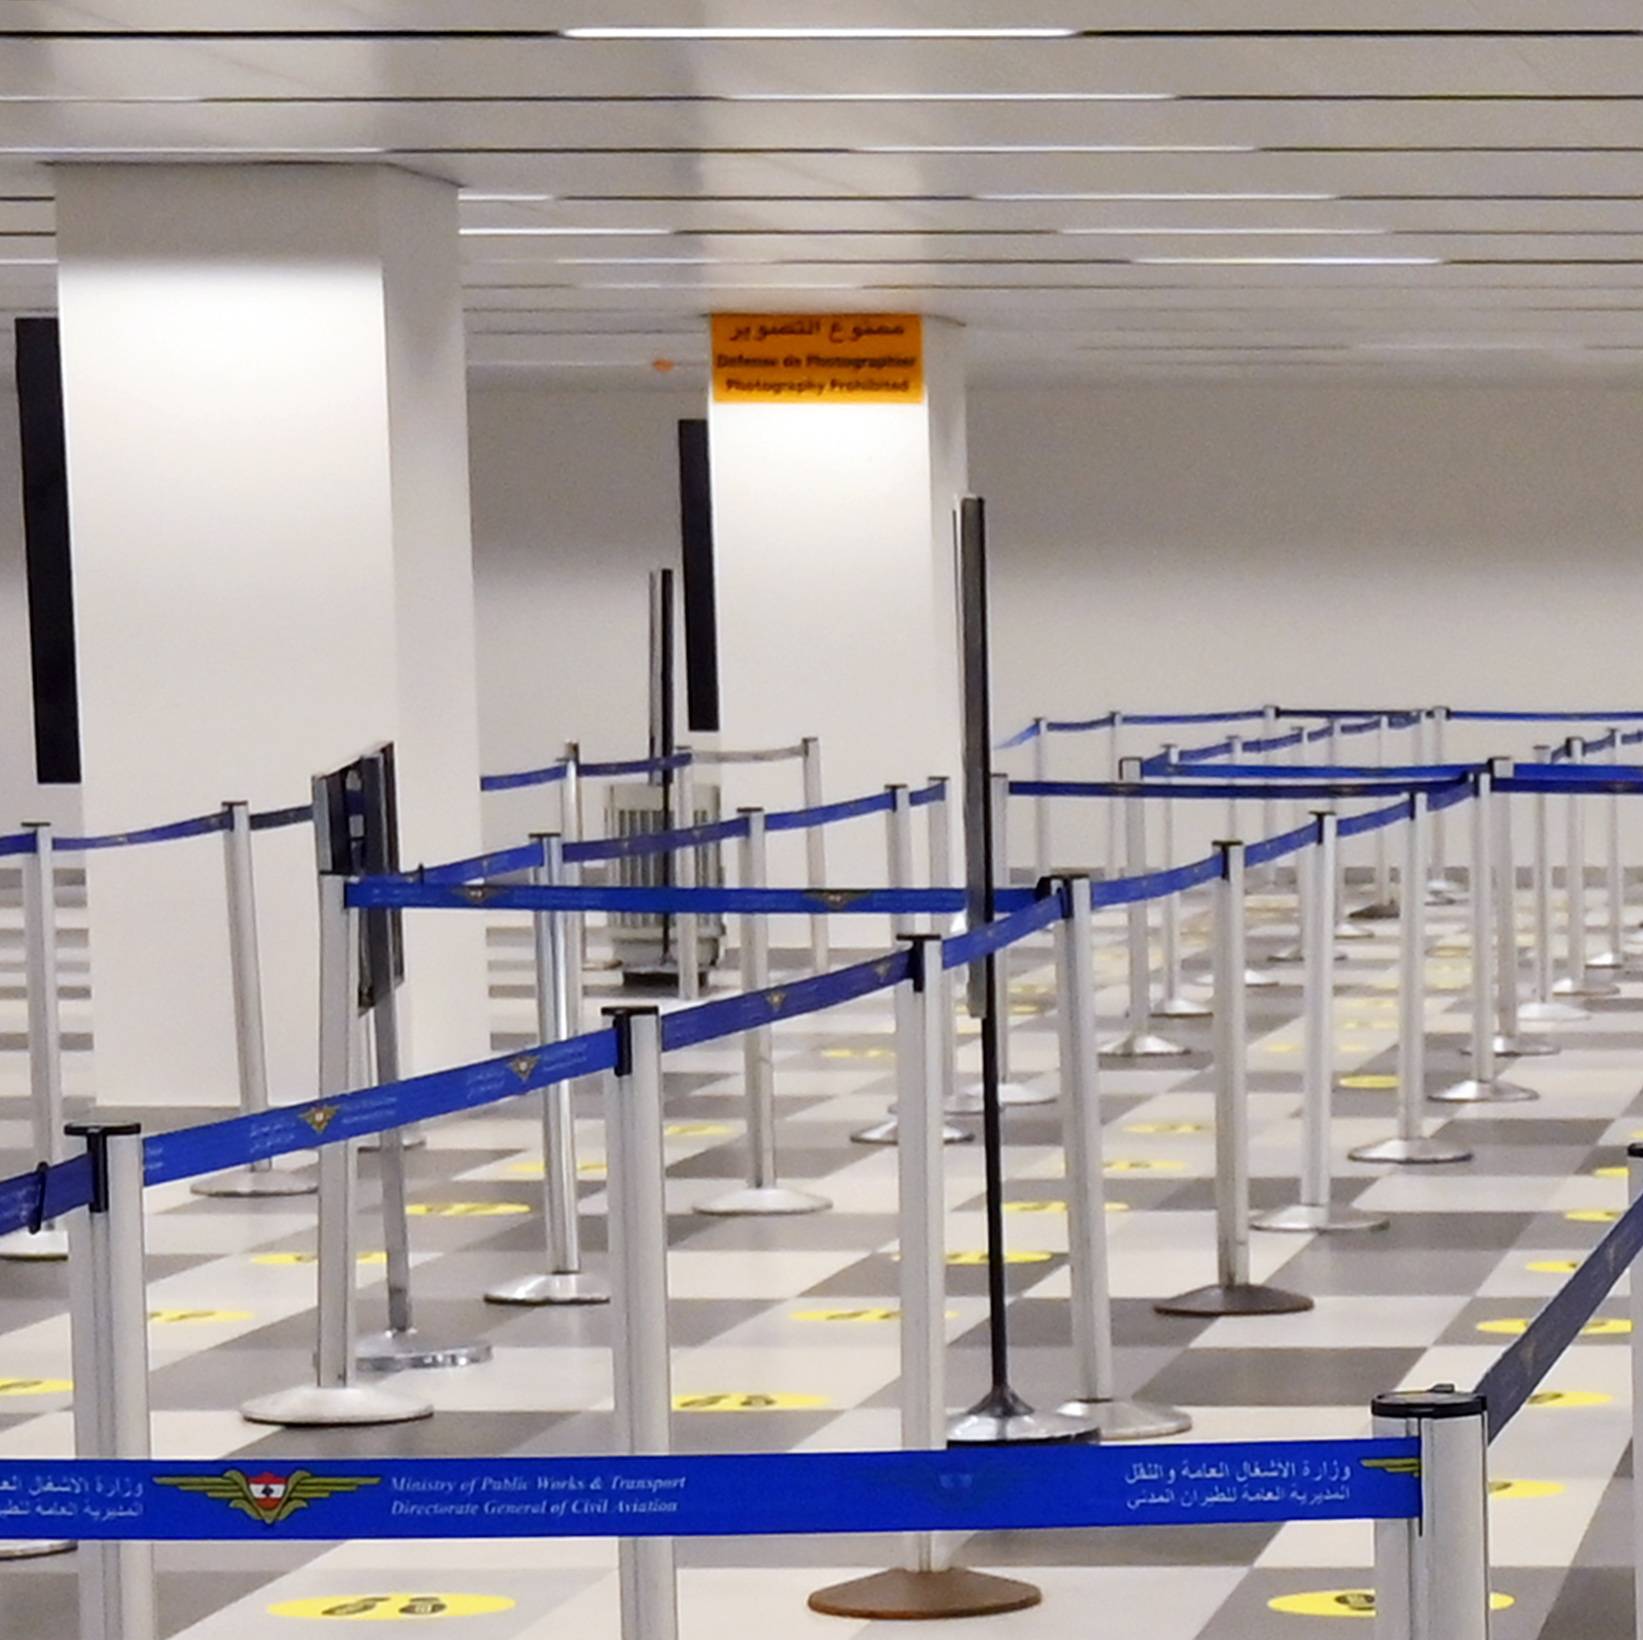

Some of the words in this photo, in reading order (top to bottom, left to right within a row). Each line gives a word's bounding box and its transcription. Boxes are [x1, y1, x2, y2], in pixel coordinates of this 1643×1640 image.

[726, 378, 825, 396] Photography
[829, 377, 910, 393] Prohibited
[1181, 1459, 1230, 1480] العامة
[1301, 1459, 1351, 1482] وزارة
[391, 1476, 454, 1494] Ministry
[460, 1476, 477, 1497] of
[481, 1475, 529, 1491] Public
[537, 1475, 586, 1491] Works
[589, 1476, 603, 1491] &
[609, 1475, 687, 1494] Transport
[1181, 1484, 1238, 1508] للطيران
[1241, 1483, 1286, 1502] العامة
[1290, 1483, 1351, 1507] المديرية
[391, 1499, 480, 1516] Directorate
[484, 1499, 548, 1516] General
[550, 1499, 566, 1518] of
[570, 1498, 609, 1515] Civil
[615, 1498, 680, 1514] Aviation
